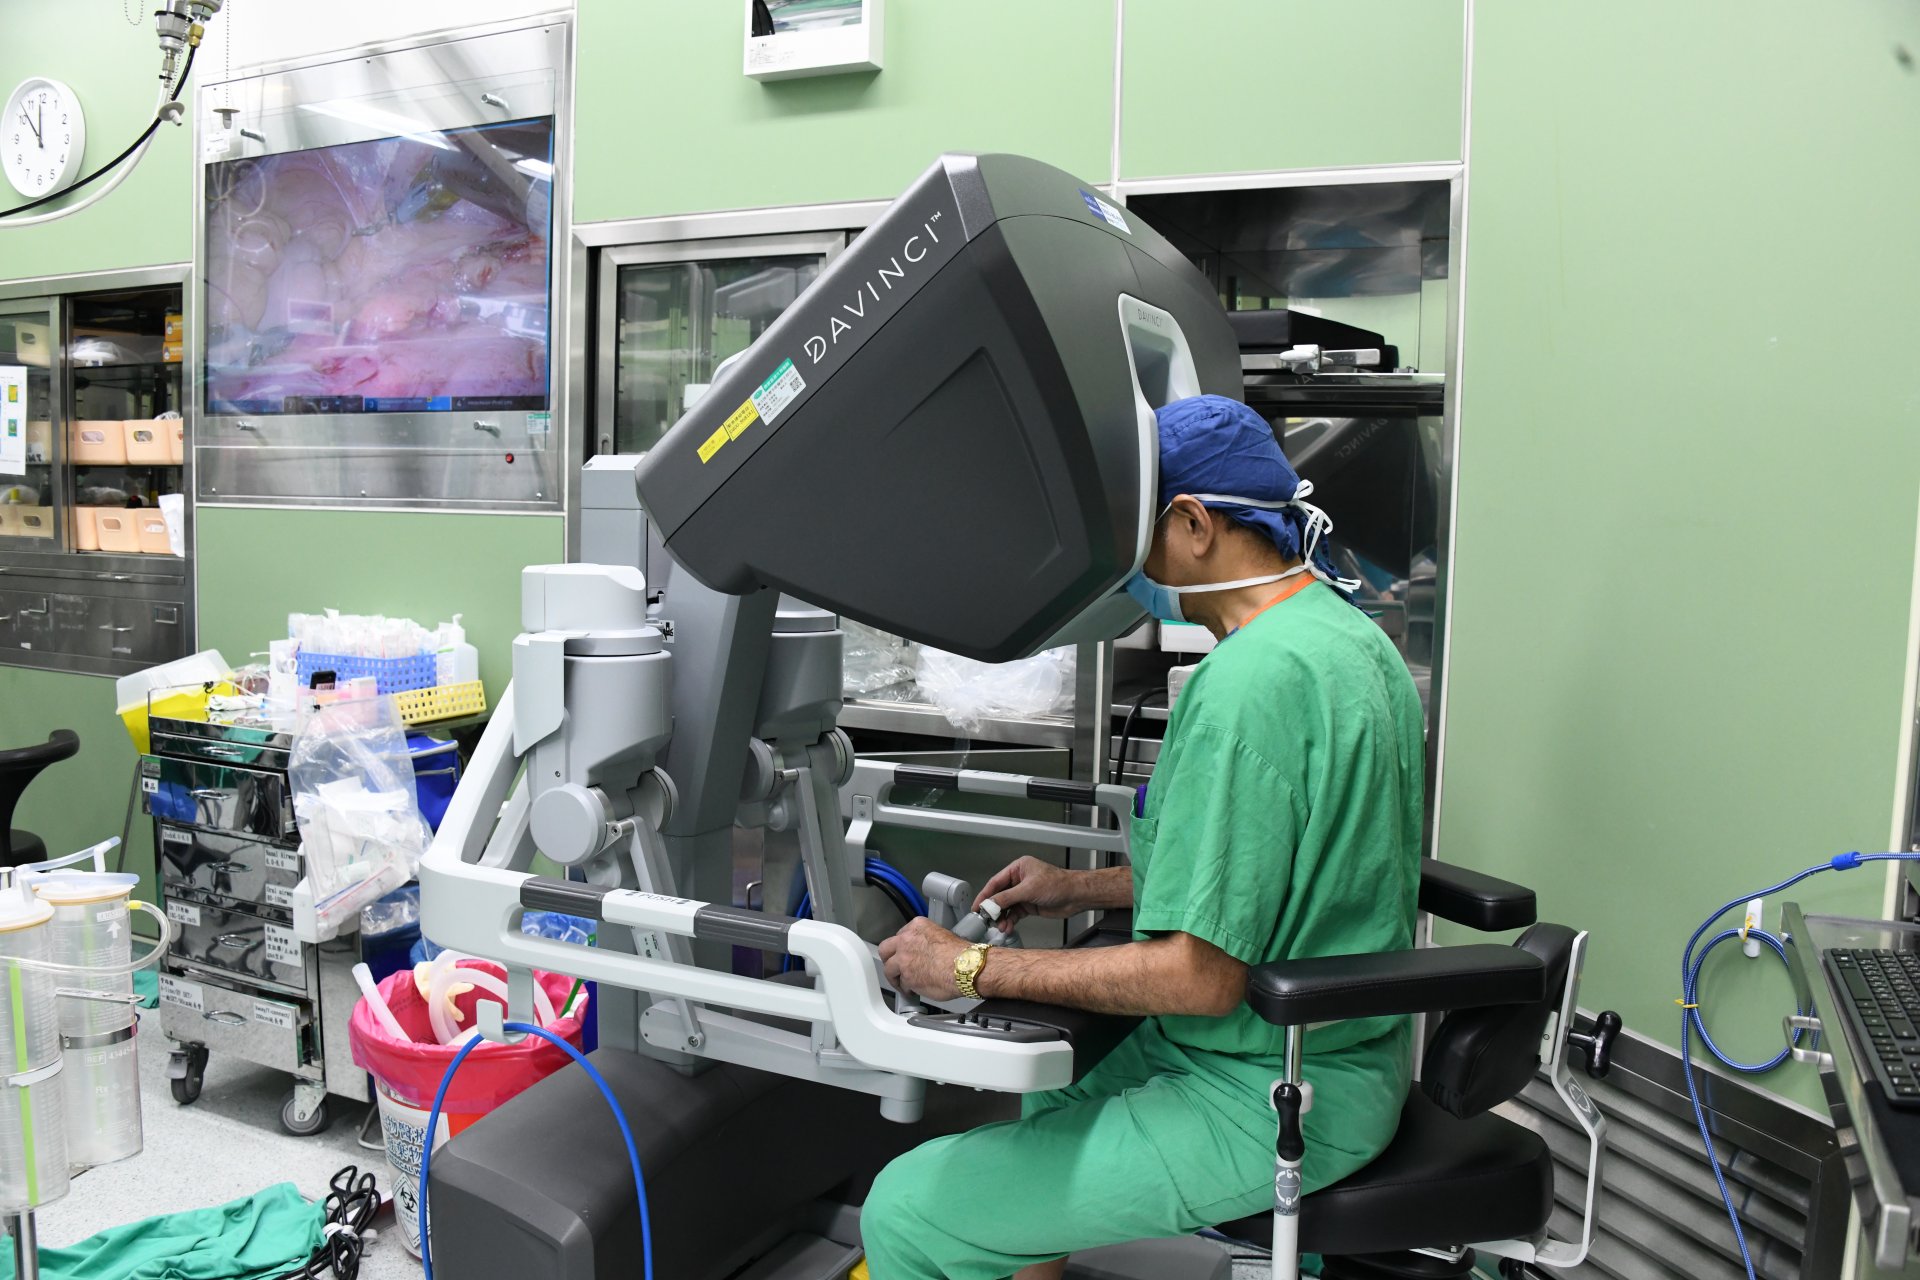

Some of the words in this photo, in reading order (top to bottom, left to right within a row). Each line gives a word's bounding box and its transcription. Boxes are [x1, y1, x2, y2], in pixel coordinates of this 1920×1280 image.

[38, 92, 47, 104] 12
[28, 100, 34, 110] 11
[54, 100, 57, 110] 1
[19, 114, 27, 125] 10
[62, 114, 67, 125] 2
[14, 134, 20, 144] 9
[64, 134, 70, 144] 3
[17, 154, 22, 164] 8
[60, 154, 64, 164] 4
[25, 168, 30, 180] 7
[50, 169, 55, 180] 5
[37, 174, 42, 186] 6
[266, 849, 278, 857] Nasal
[640, 894, 676, 902] PUSH
